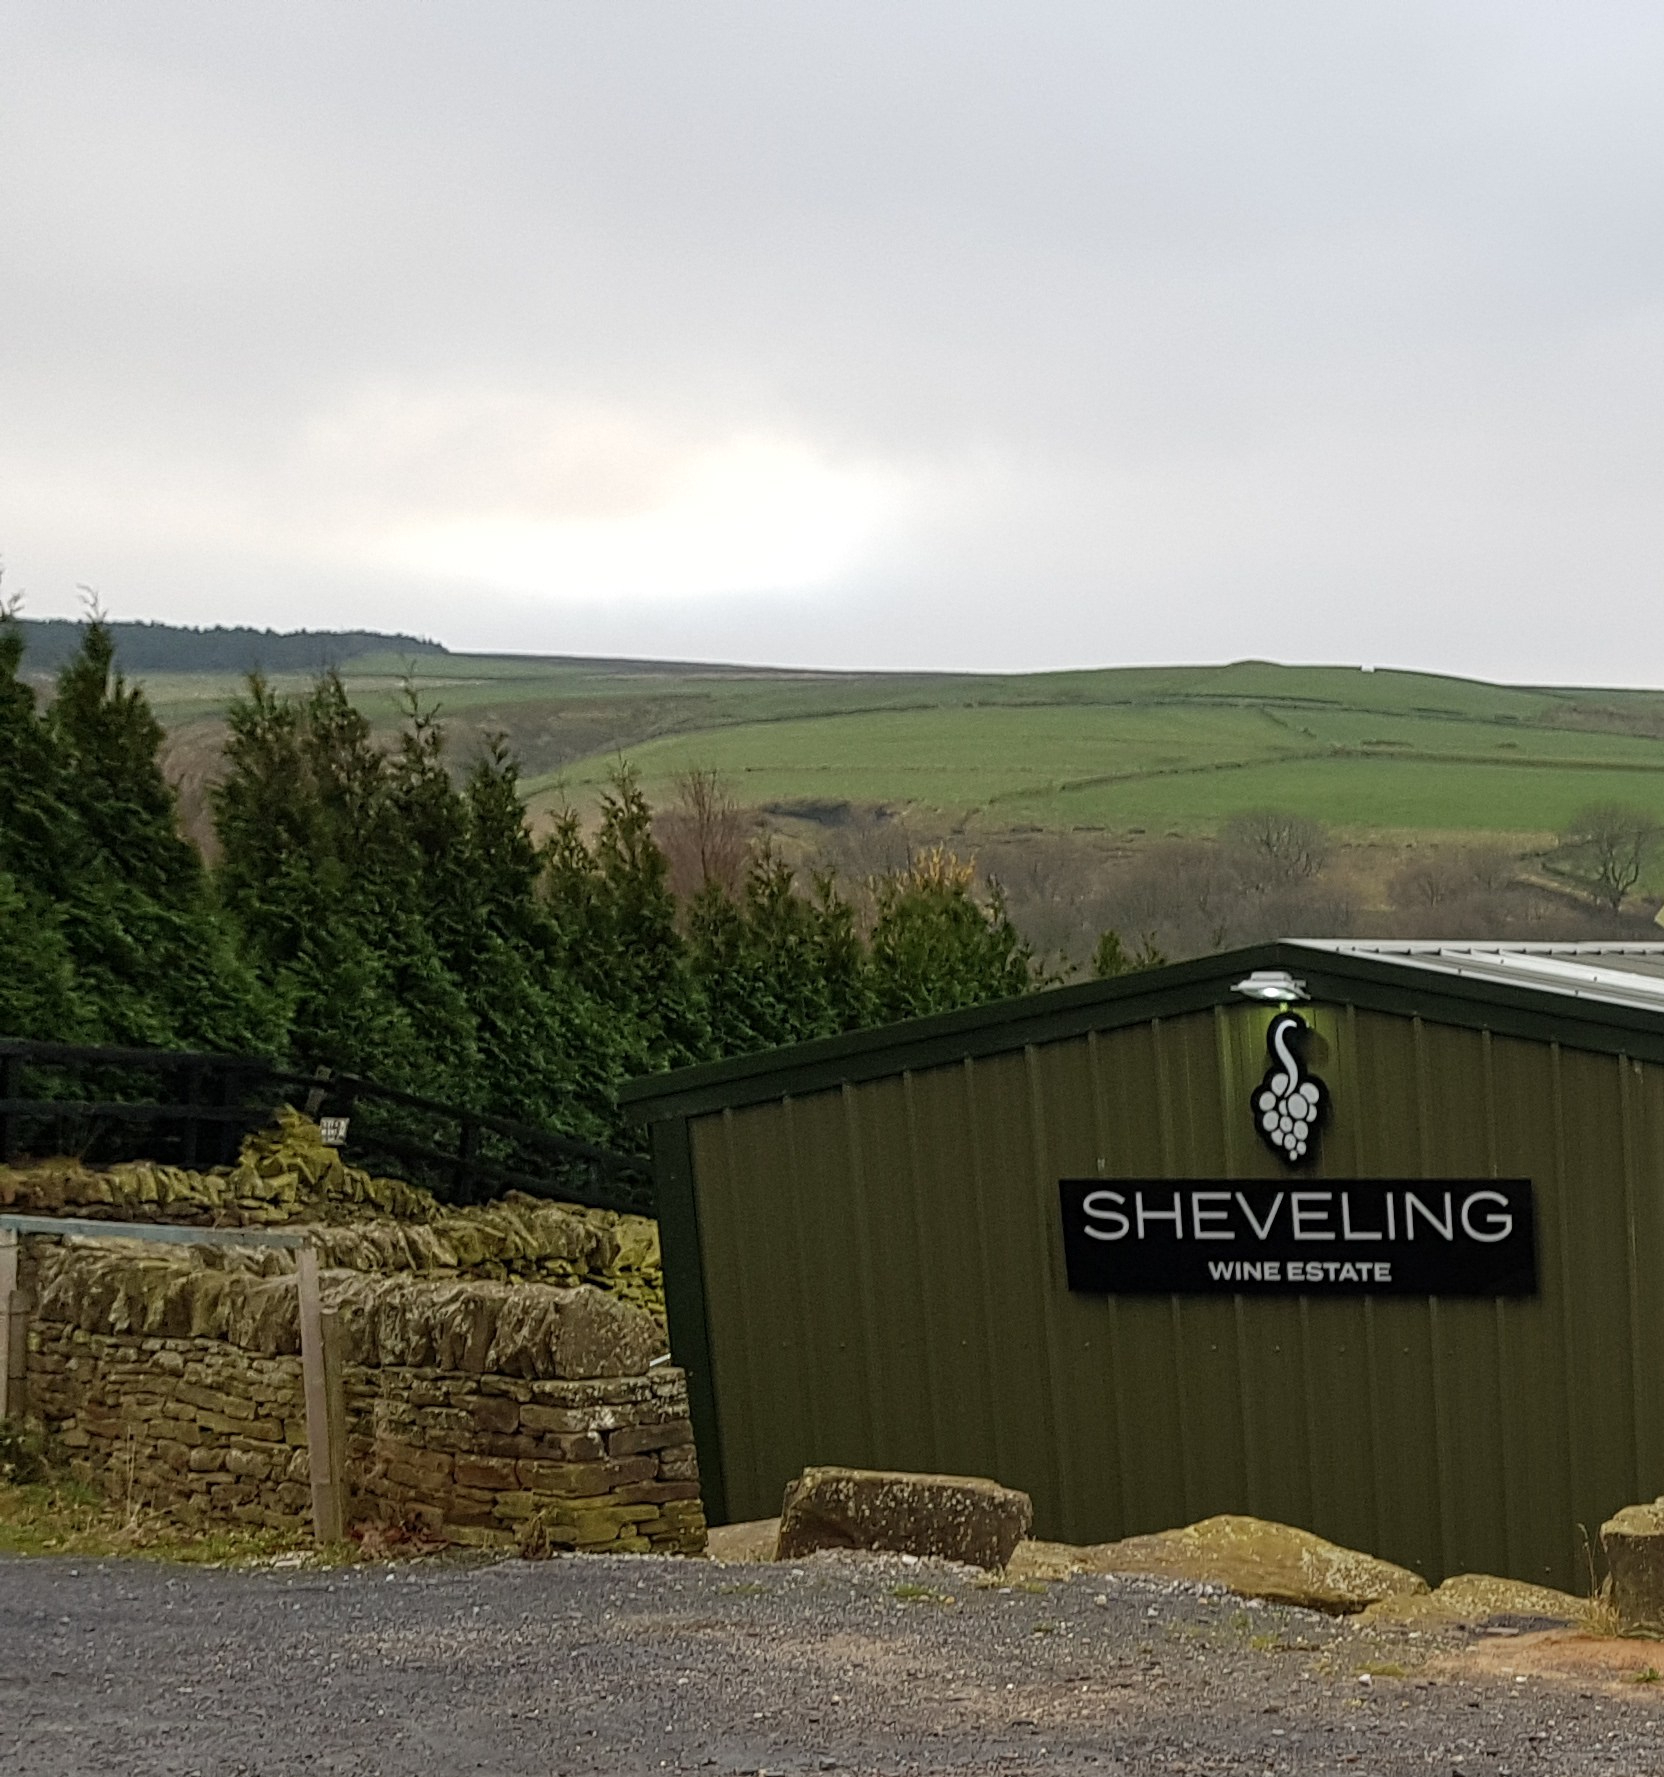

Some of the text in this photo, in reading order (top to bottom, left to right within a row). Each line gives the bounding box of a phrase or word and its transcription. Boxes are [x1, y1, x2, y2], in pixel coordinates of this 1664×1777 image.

[1082, 1190, 1513, 1243] SHEVELING
[1207, 1261, 1393, 1283] WINE ESTATE
